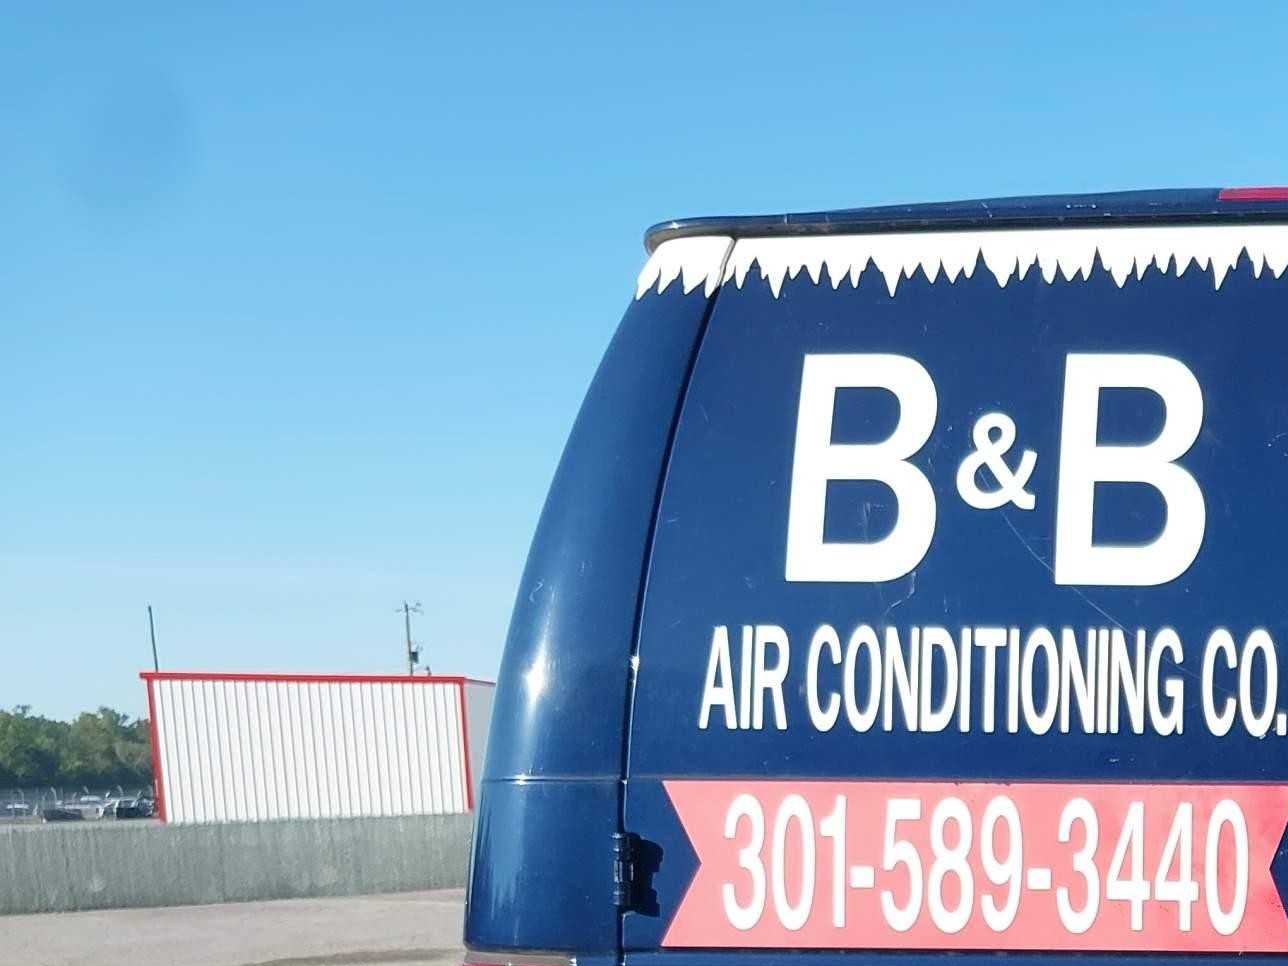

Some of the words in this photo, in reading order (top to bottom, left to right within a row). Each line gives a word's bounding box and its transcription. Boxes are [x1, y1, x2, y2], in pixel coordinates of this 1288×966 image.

[698, 624, 790, 731] AIR
[806, 624, 1184, 737] CONDITIONING
[1201, 628, 1288, 738] CO.
[721, 793, 1249, 936] 301-589-3440
